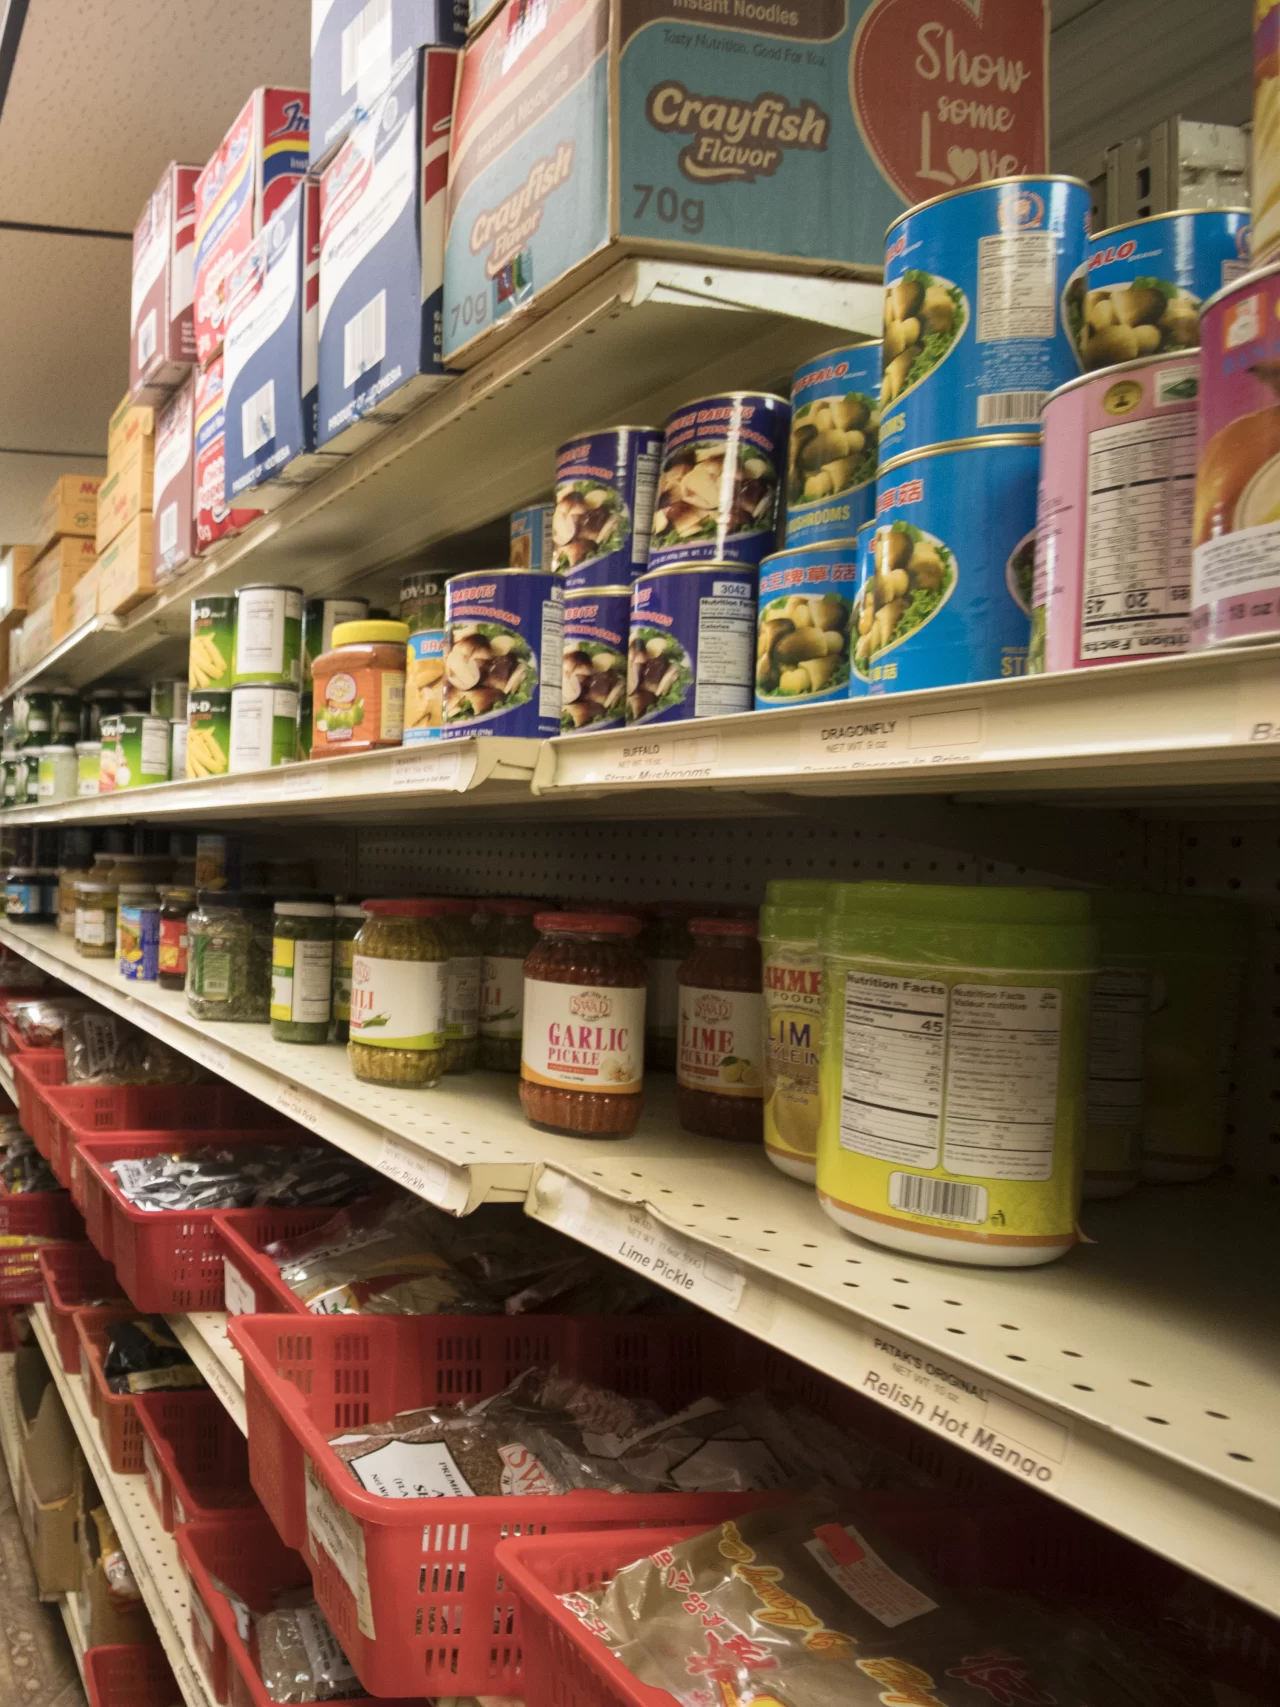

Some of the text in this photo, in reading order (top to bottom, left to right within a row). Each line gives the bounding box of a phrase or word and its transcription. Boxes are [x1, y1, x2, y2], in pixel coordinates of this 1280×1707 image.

[733, 0, 799, 26] Noodles
[916, 22, 1030, 94] Show
[651, 87, 827, 146] Crayfish
[937, 95, 1015, 132] some
[697, 137, 777, 168] Flavor
[472, 146, 573, 249] Crayfish
[632, 184, 705, 235] 70g
[495, 208, 541, 257] Flavor
[449, 291, 488, 338] 70g
[720, 583, 746, 596] 3042
[1086, 591, 1150, 615] 20 45
[1084, 633, 1189, 654] rition Facts
[821, 720, 898, 741] DRAGONFLY
[623, 744, 661, 758] BUFFALO
[825, 743, 845, 754] NET
[847, 973, 945, 996] Nutrition Facts
[572, 1000, 609, 1014] SWAD
[548, 1021, 630, 1052] GARLIC
[680, 1022, 735, 1054] LIME
[921, 1019, 944, 1033] 45
[548, 1047, 601, 1066] PICKLE
[680, 1050, 720, 1067] PICKLE
[401, 1170, 426, 1192] Pickle
[619, 1241, 695, 1291] Lime Pickle
[874, 1337, 989, 1404] PATAK'S ORIGINAL
[863, 1370, 1052, 1482] Relish Hot Mango
